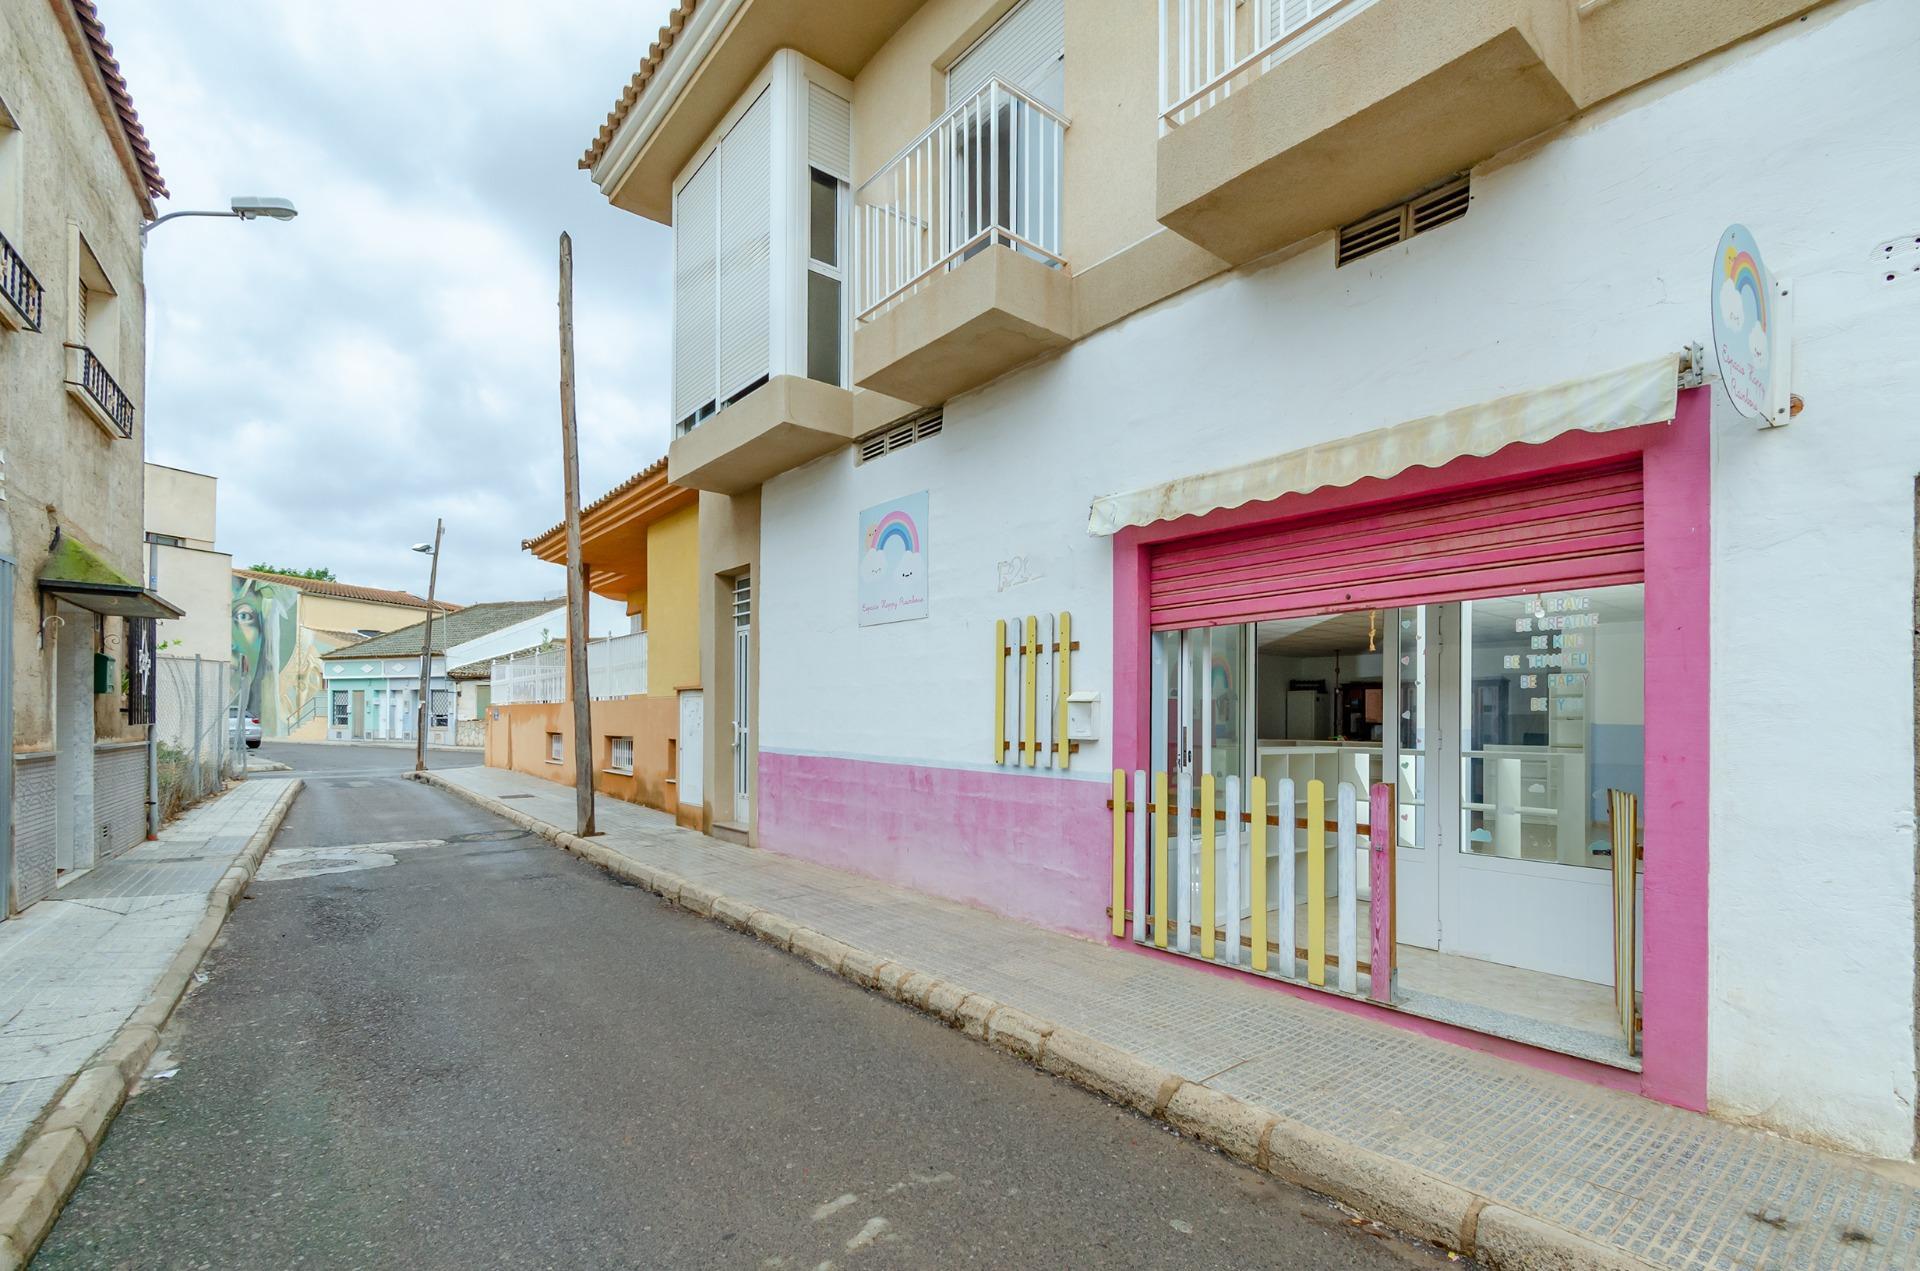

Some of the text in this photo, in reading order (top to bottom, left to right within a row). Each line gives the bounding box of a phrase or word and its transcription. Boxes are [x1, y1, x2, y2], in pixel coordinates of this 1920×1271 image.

[1547, 597, 1590, 612] BRAVE
[1515, 613, 1600, 632] BE CREATIVE
[1531, 635, 1548, 650] BE
[1503, 654, 1520, 669] BE
[1520, 674, 1537, 689] BE
[1530, 697, 1548, 712] BE
